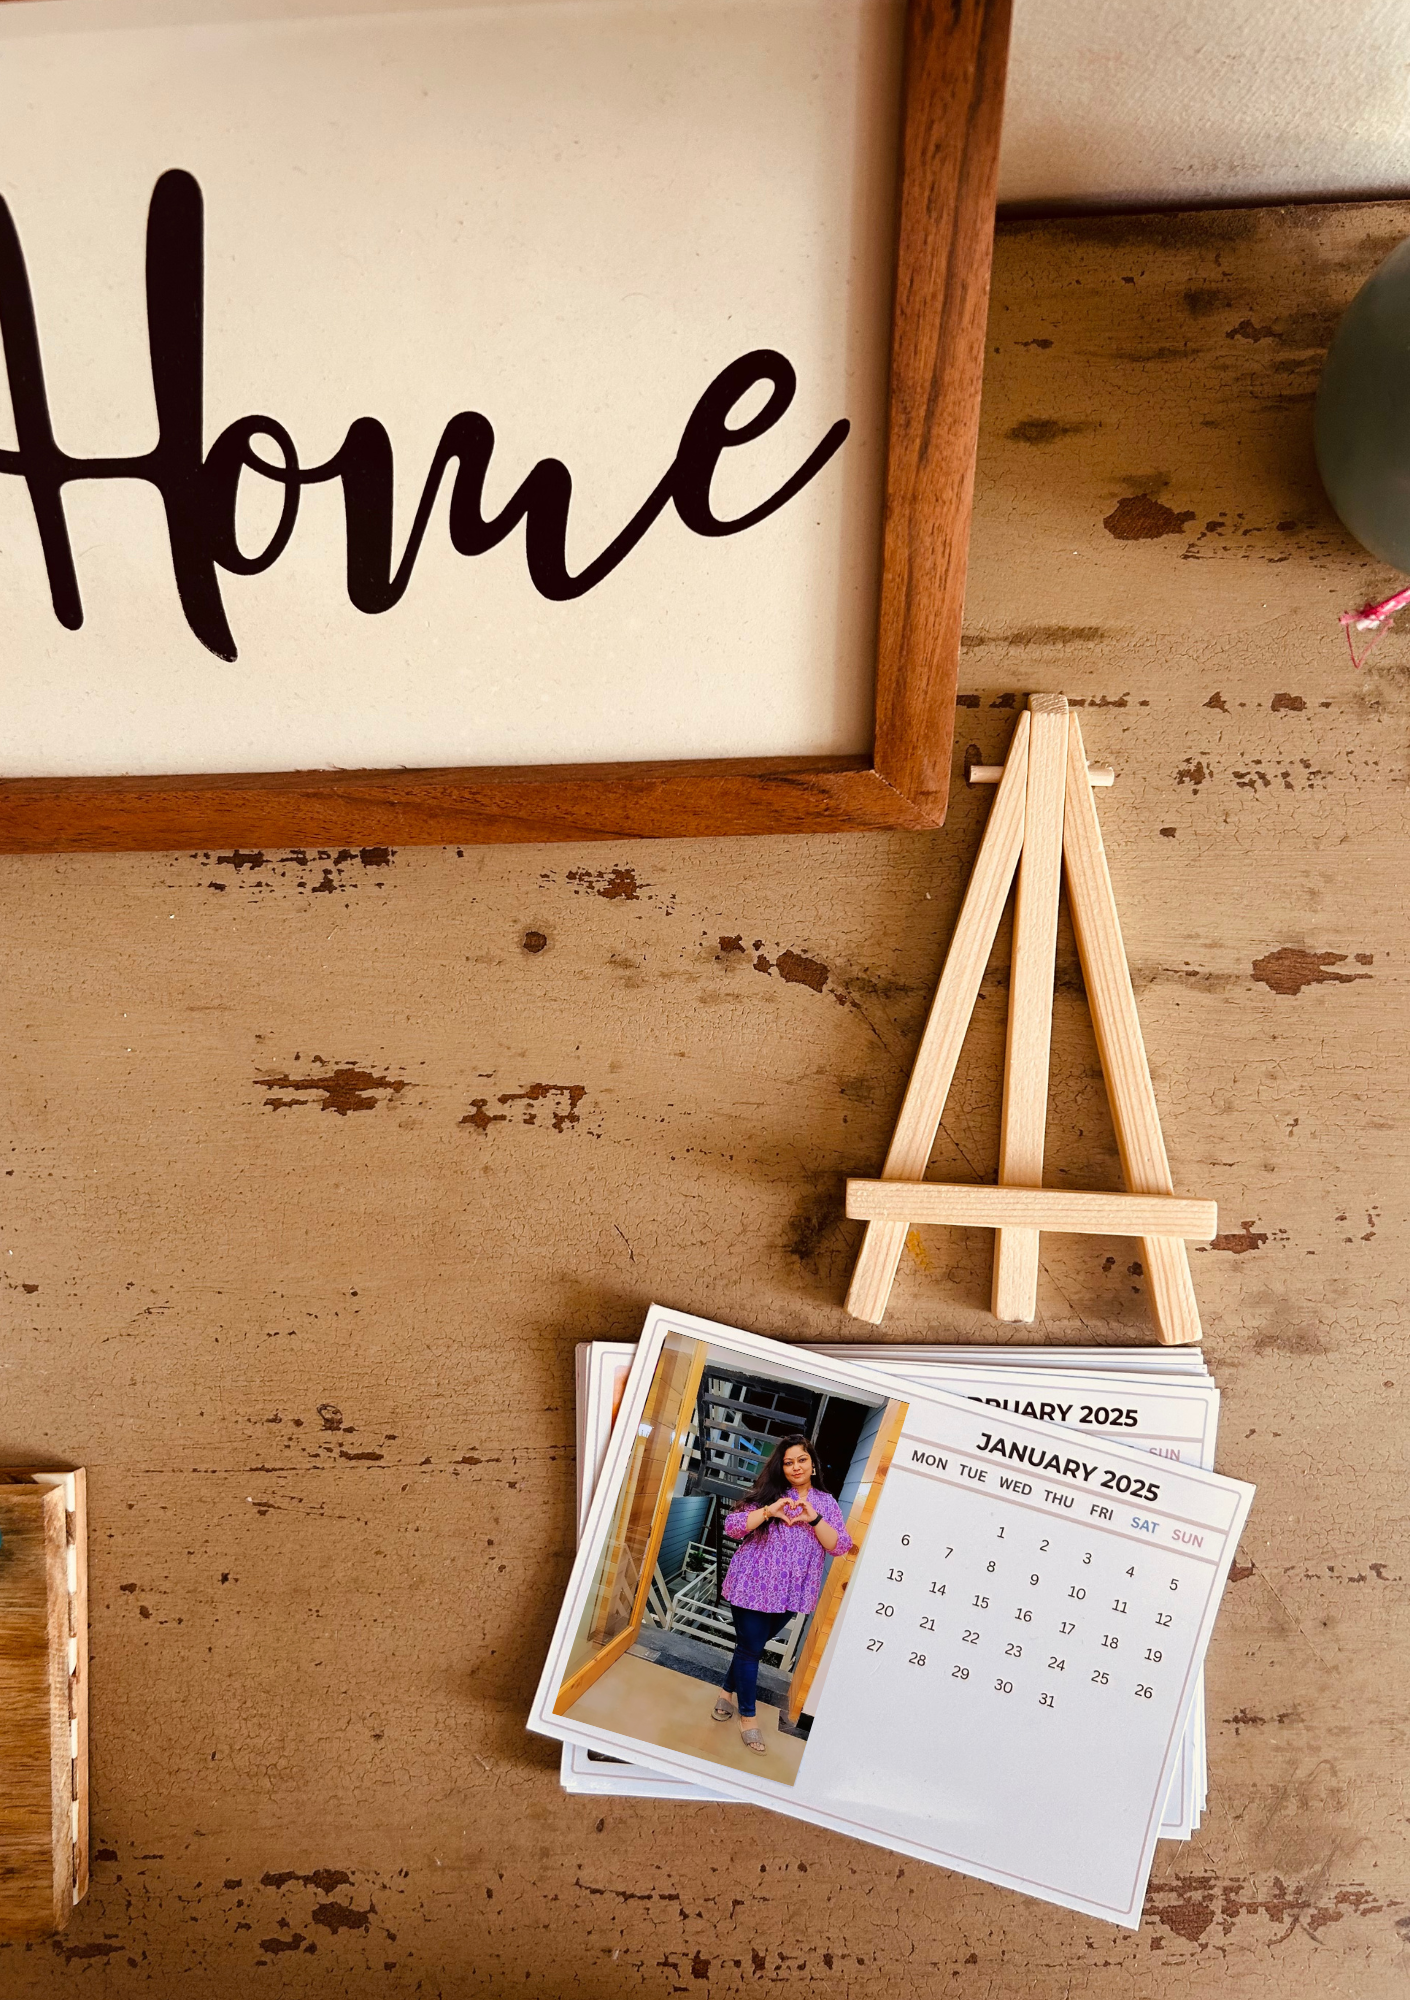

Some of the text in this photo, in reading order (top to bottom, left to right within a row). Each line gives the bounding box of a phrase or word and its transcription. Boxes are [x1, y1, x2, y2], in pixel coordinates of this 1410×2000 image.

[0, 169, 851, 662] Home
[1079, 1405, 1139, 1428] 2025
[912, 1450, 1203, 1548] MON TUE WED THU FRI SAT SUN
[976, 1432, 1161, 1502] JANUARY 2025
[901, 1534, 1173, 1628] 6 7 8 9 10 11 12
[996, 1526, 1180, 1591] 1 2 3 4 5
[875, 1602, 1154, 1700] 20 21 22 23 24 25 26
[886, 1568, 1163, 1663] 13 14 15 16 17 18 19
[866, 1638, 1055, 1709] 27 28 29 30 31
